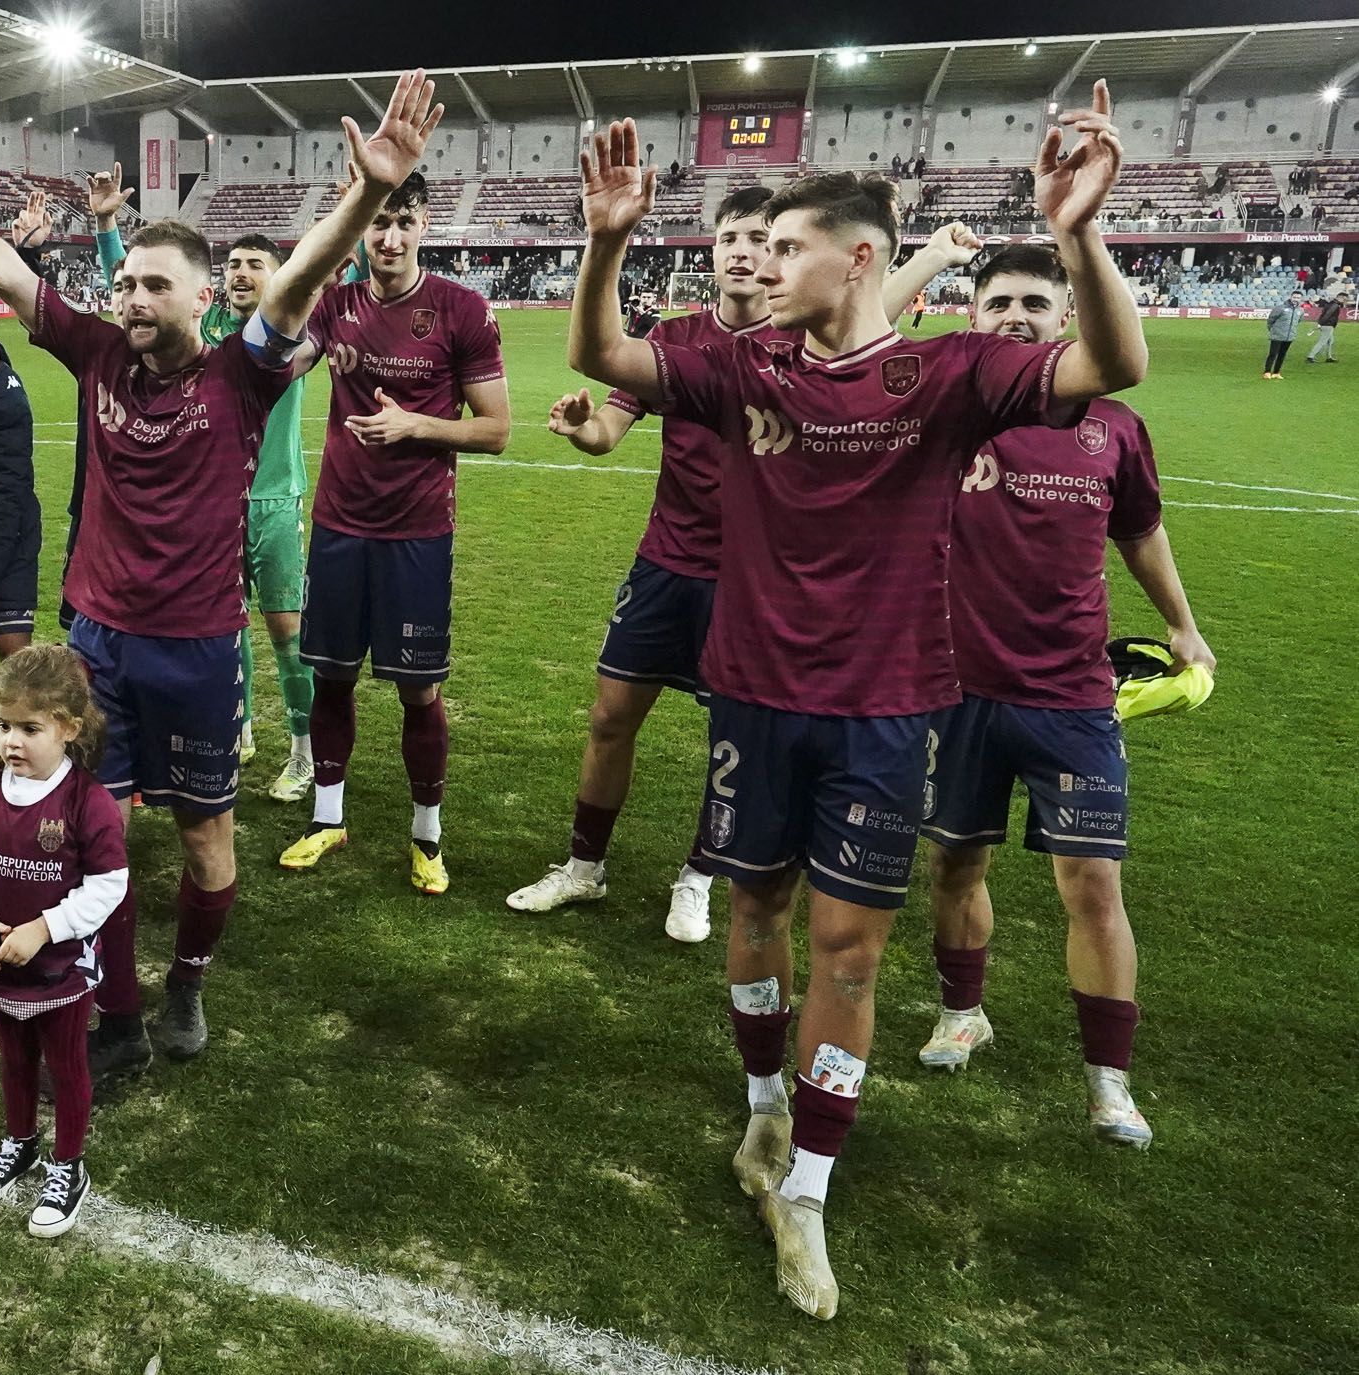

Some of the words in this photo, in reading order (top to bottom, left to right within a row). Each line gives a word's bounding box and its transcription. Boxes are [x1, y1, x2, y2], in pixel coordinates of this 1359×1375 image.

[730, 119, 738, 130] 0
[762, 118, 770, 128] 0
[1247, 234, 1272, 242] Diario
[1282, 234, 1329, 242] Pontevedra
[364, 353, 433, 368] Deputación
[362, 364, 432, 380] Pontevedra
[132, 402, 207, 436] Depución
[127, 416, 209, 444] Pontedra
[802, 417, 921, 439] Deputación
[802, 433, 920, 452] Pontevedra
[1006, 482, 1101, 507] Pontevedra
[712, 740, 740, 798] 2
[190, 773, 222, 782] DEPORTE
[190, 782, 221, 791] GALEGO
[1074, 783, 1087, 791] DE
[1090, 783, 1122, 793] GALICIA
[869, 810, 903, 822] XUNTA
[1082, 810, 1122, 821] DEPORTE
[867, 818, 880, 828] DE
[883, 821, 915, 834] GALICIA
[1082, 820, 1118, 831] GALEGO
[868, 852, 908, 866] DEPORTE
[866, 864, 904, 878] GALEGO
